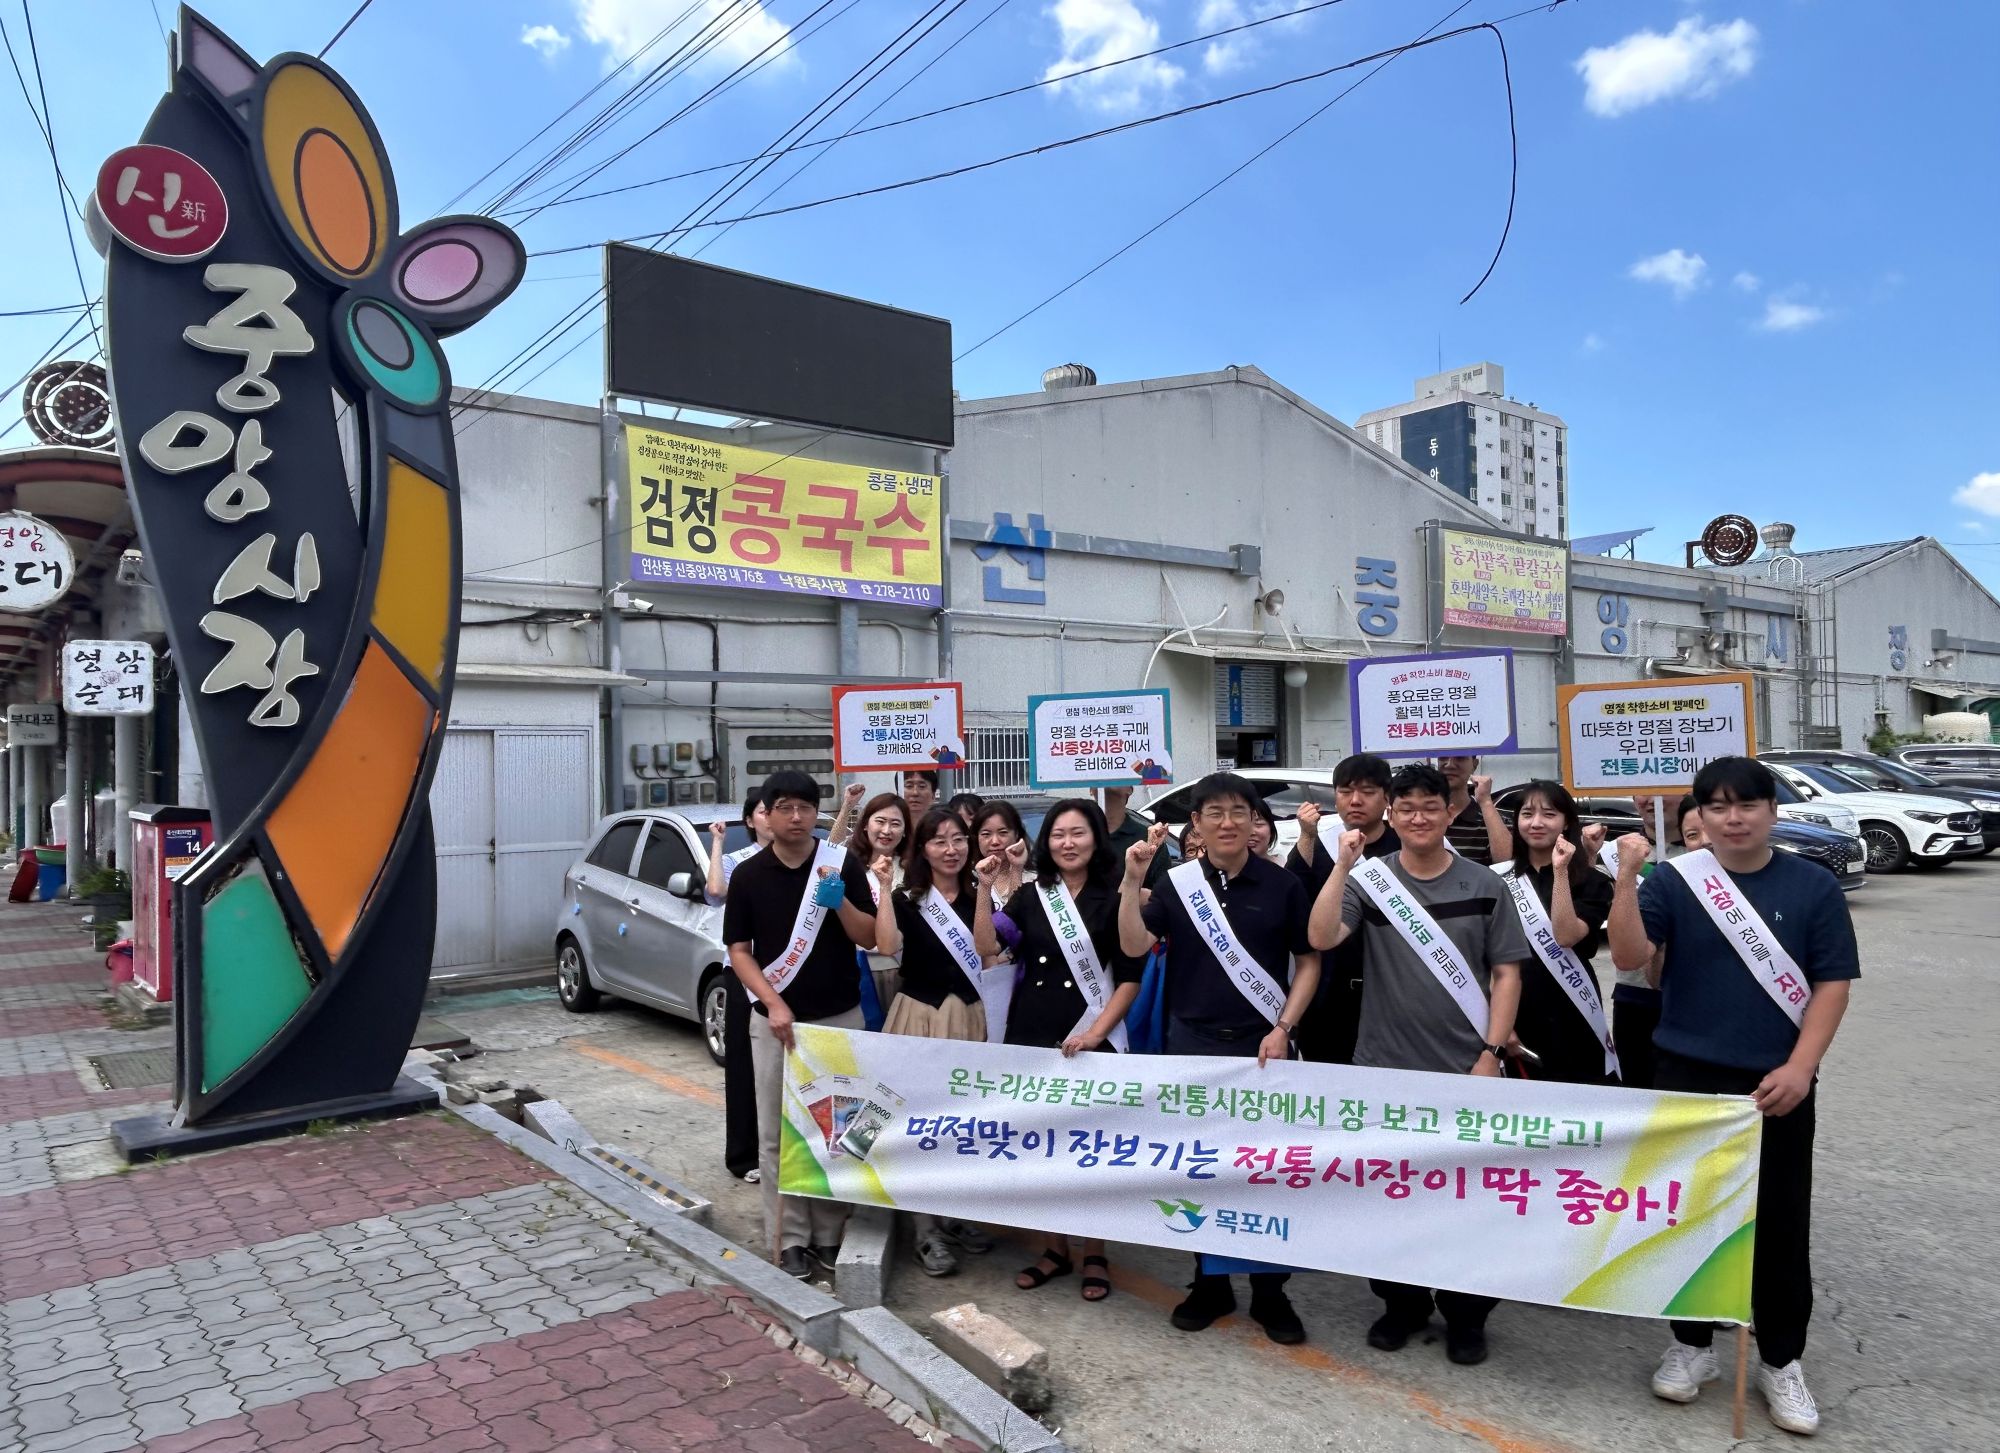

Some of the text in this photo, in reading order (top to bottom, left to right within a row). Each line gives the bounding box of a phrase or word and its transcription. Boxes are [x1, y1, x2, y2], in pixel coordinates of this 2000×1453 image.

[116, 166, 200, 238] 신
[181, 199, 206, 223] 新
[139, 263, 319, 728] 중앙시장
[642, 558, 672, 577] 연산동
[675, 562, 727, 581] 신중앙시장
[729, 569, 741, 582] 내
[742, 570, 766, 584] 76호
[874, 584, 930, 600] 278-2110
[971, 512, 1908, 671] 신 중 앙 시 장
[1409, 668, 1443, 679] 착한소비
[1387, 685, 1477, 704] 풍요로운 명절
[1395, 703, 1471, 720] 활력 넘치는
[1604, 698, 1705, 715] 명절 착한소비 캠페인
[868, 714, 929, 727] 명절 장보기
[1050, 722, 1149, 739] 명절 성수품 구매
[1387, 721, 1481, 739] 전통시장에서
[1581, 716, 1733, 738] 따뜻한 명절 장보기
[862, 728, 937, 742] 전통시장에서
[1619, 737, 1695, 755] 우리 동네
[877, 743, 923, 755] 함께해요
[1050, 739, 1150, 756] 신중앙시장에서
[1074, 757, 1127, 771] 준비해요
[186, 842, 200, 853] 14
[1704, 875, 1746, 924] 시장에
[927, 902, 978, 969] 명절 착한소비
[1189, 889, 1240, 966] 전통시장을
[1365, 869, 1467, 988] 명절 착한소비 캠페인
[1534, 927, 1599, 1013] 전통시장에서
[948, 1068, 1604, 1150] 온누리상품권으로 전통시장에서 장 보고 할인받고!
[906, 1115, 1682, 1226] 명절맞이 장보기는 전통시장이 딱 좋아!
[1214, 1209, 1290, 1242] 목포시
